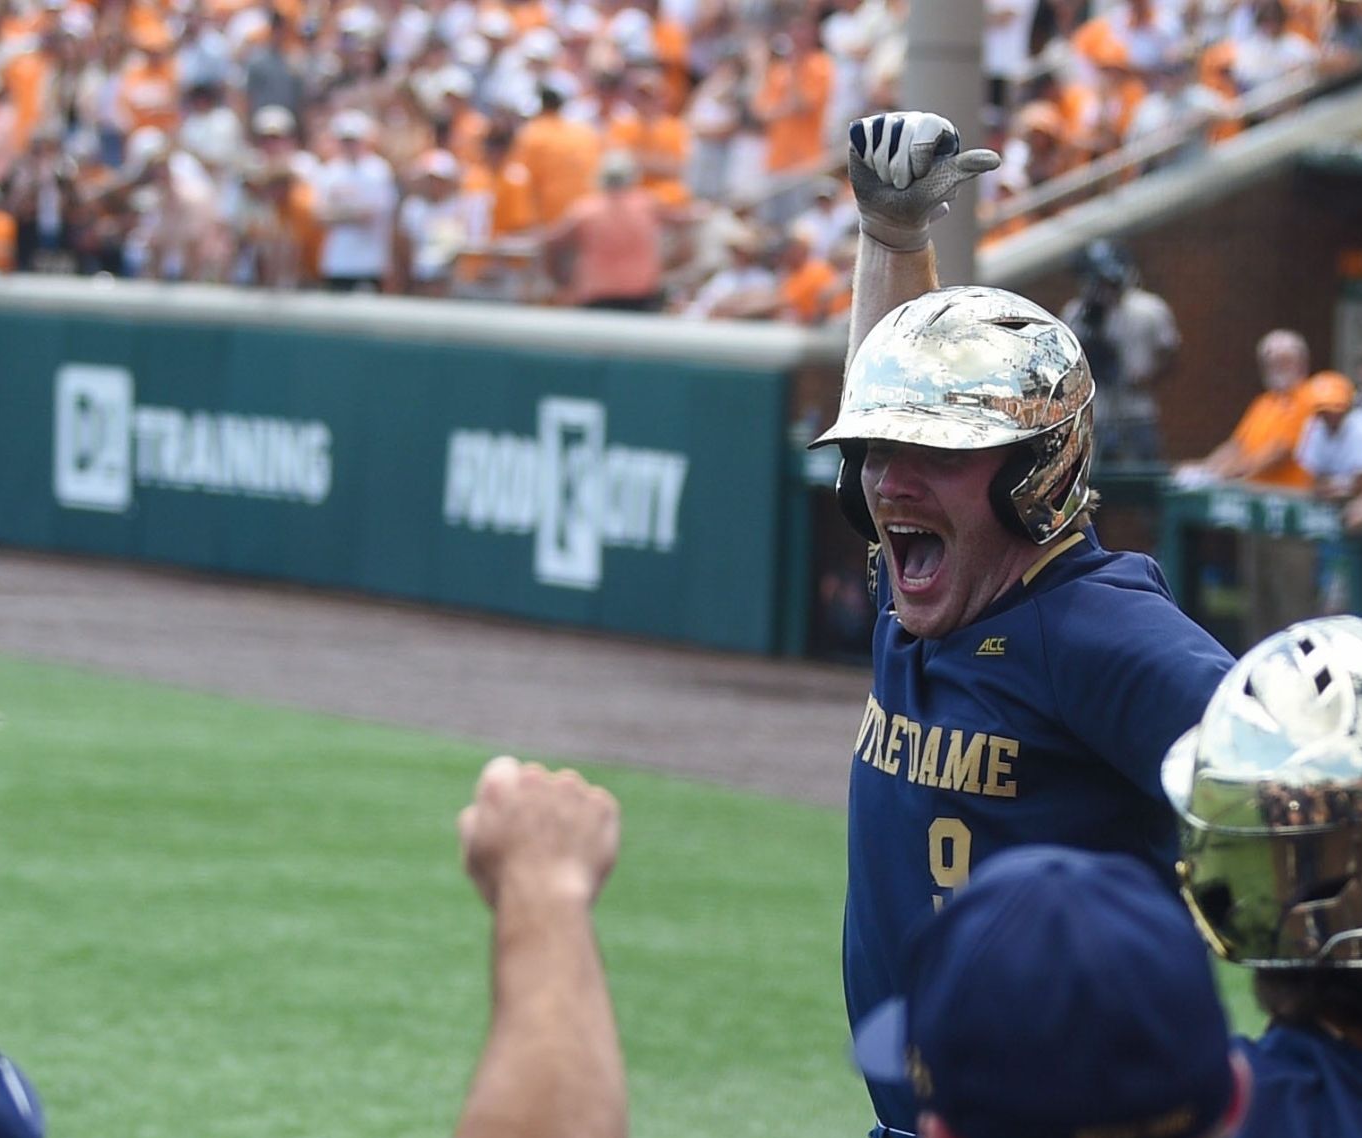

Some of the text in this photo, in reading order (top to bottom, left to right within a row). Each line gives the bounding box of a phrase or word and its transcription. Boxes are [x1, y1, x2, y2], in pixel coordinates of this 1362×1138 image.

[136, 402, 333, 506] TRAINING
[977, 637, 1007, 655] ACC
[907, 720, 1020, 798] DAME
[927, 817, 972, 914] 9
